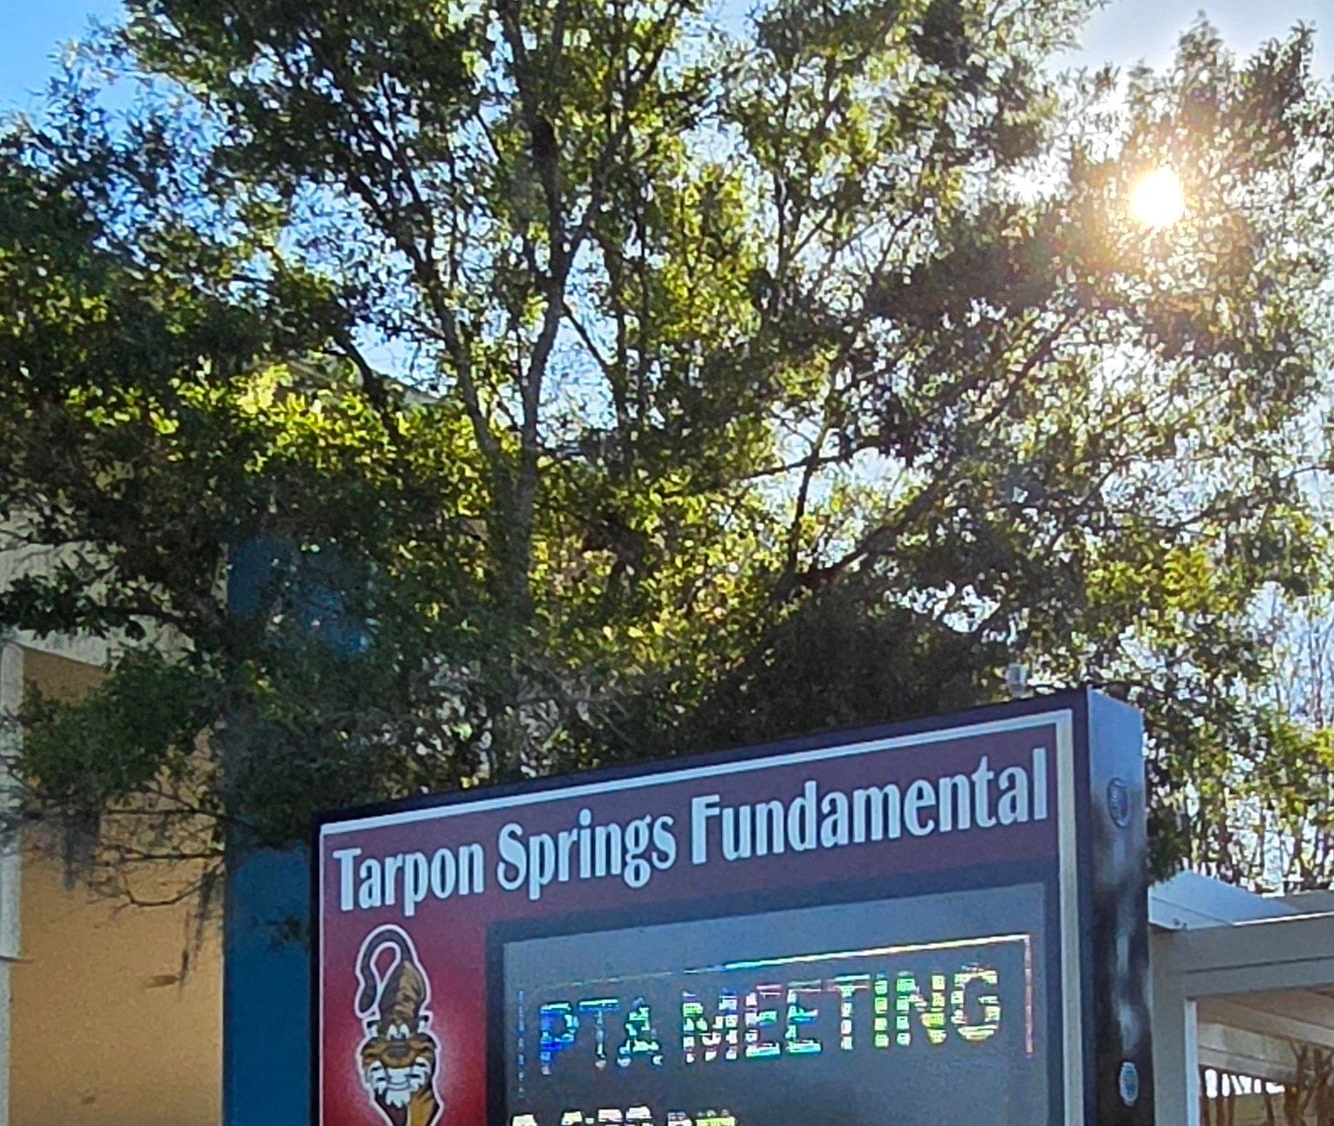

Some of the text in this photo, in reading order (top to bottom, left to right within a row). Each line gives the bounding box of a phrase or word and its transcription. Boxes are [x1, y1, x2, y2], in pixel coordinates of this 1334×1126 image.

[333, 747, 1048, 917] Tarpon Springs Fundamental
[540, 963, 1000, 1075] PTA MEETING
